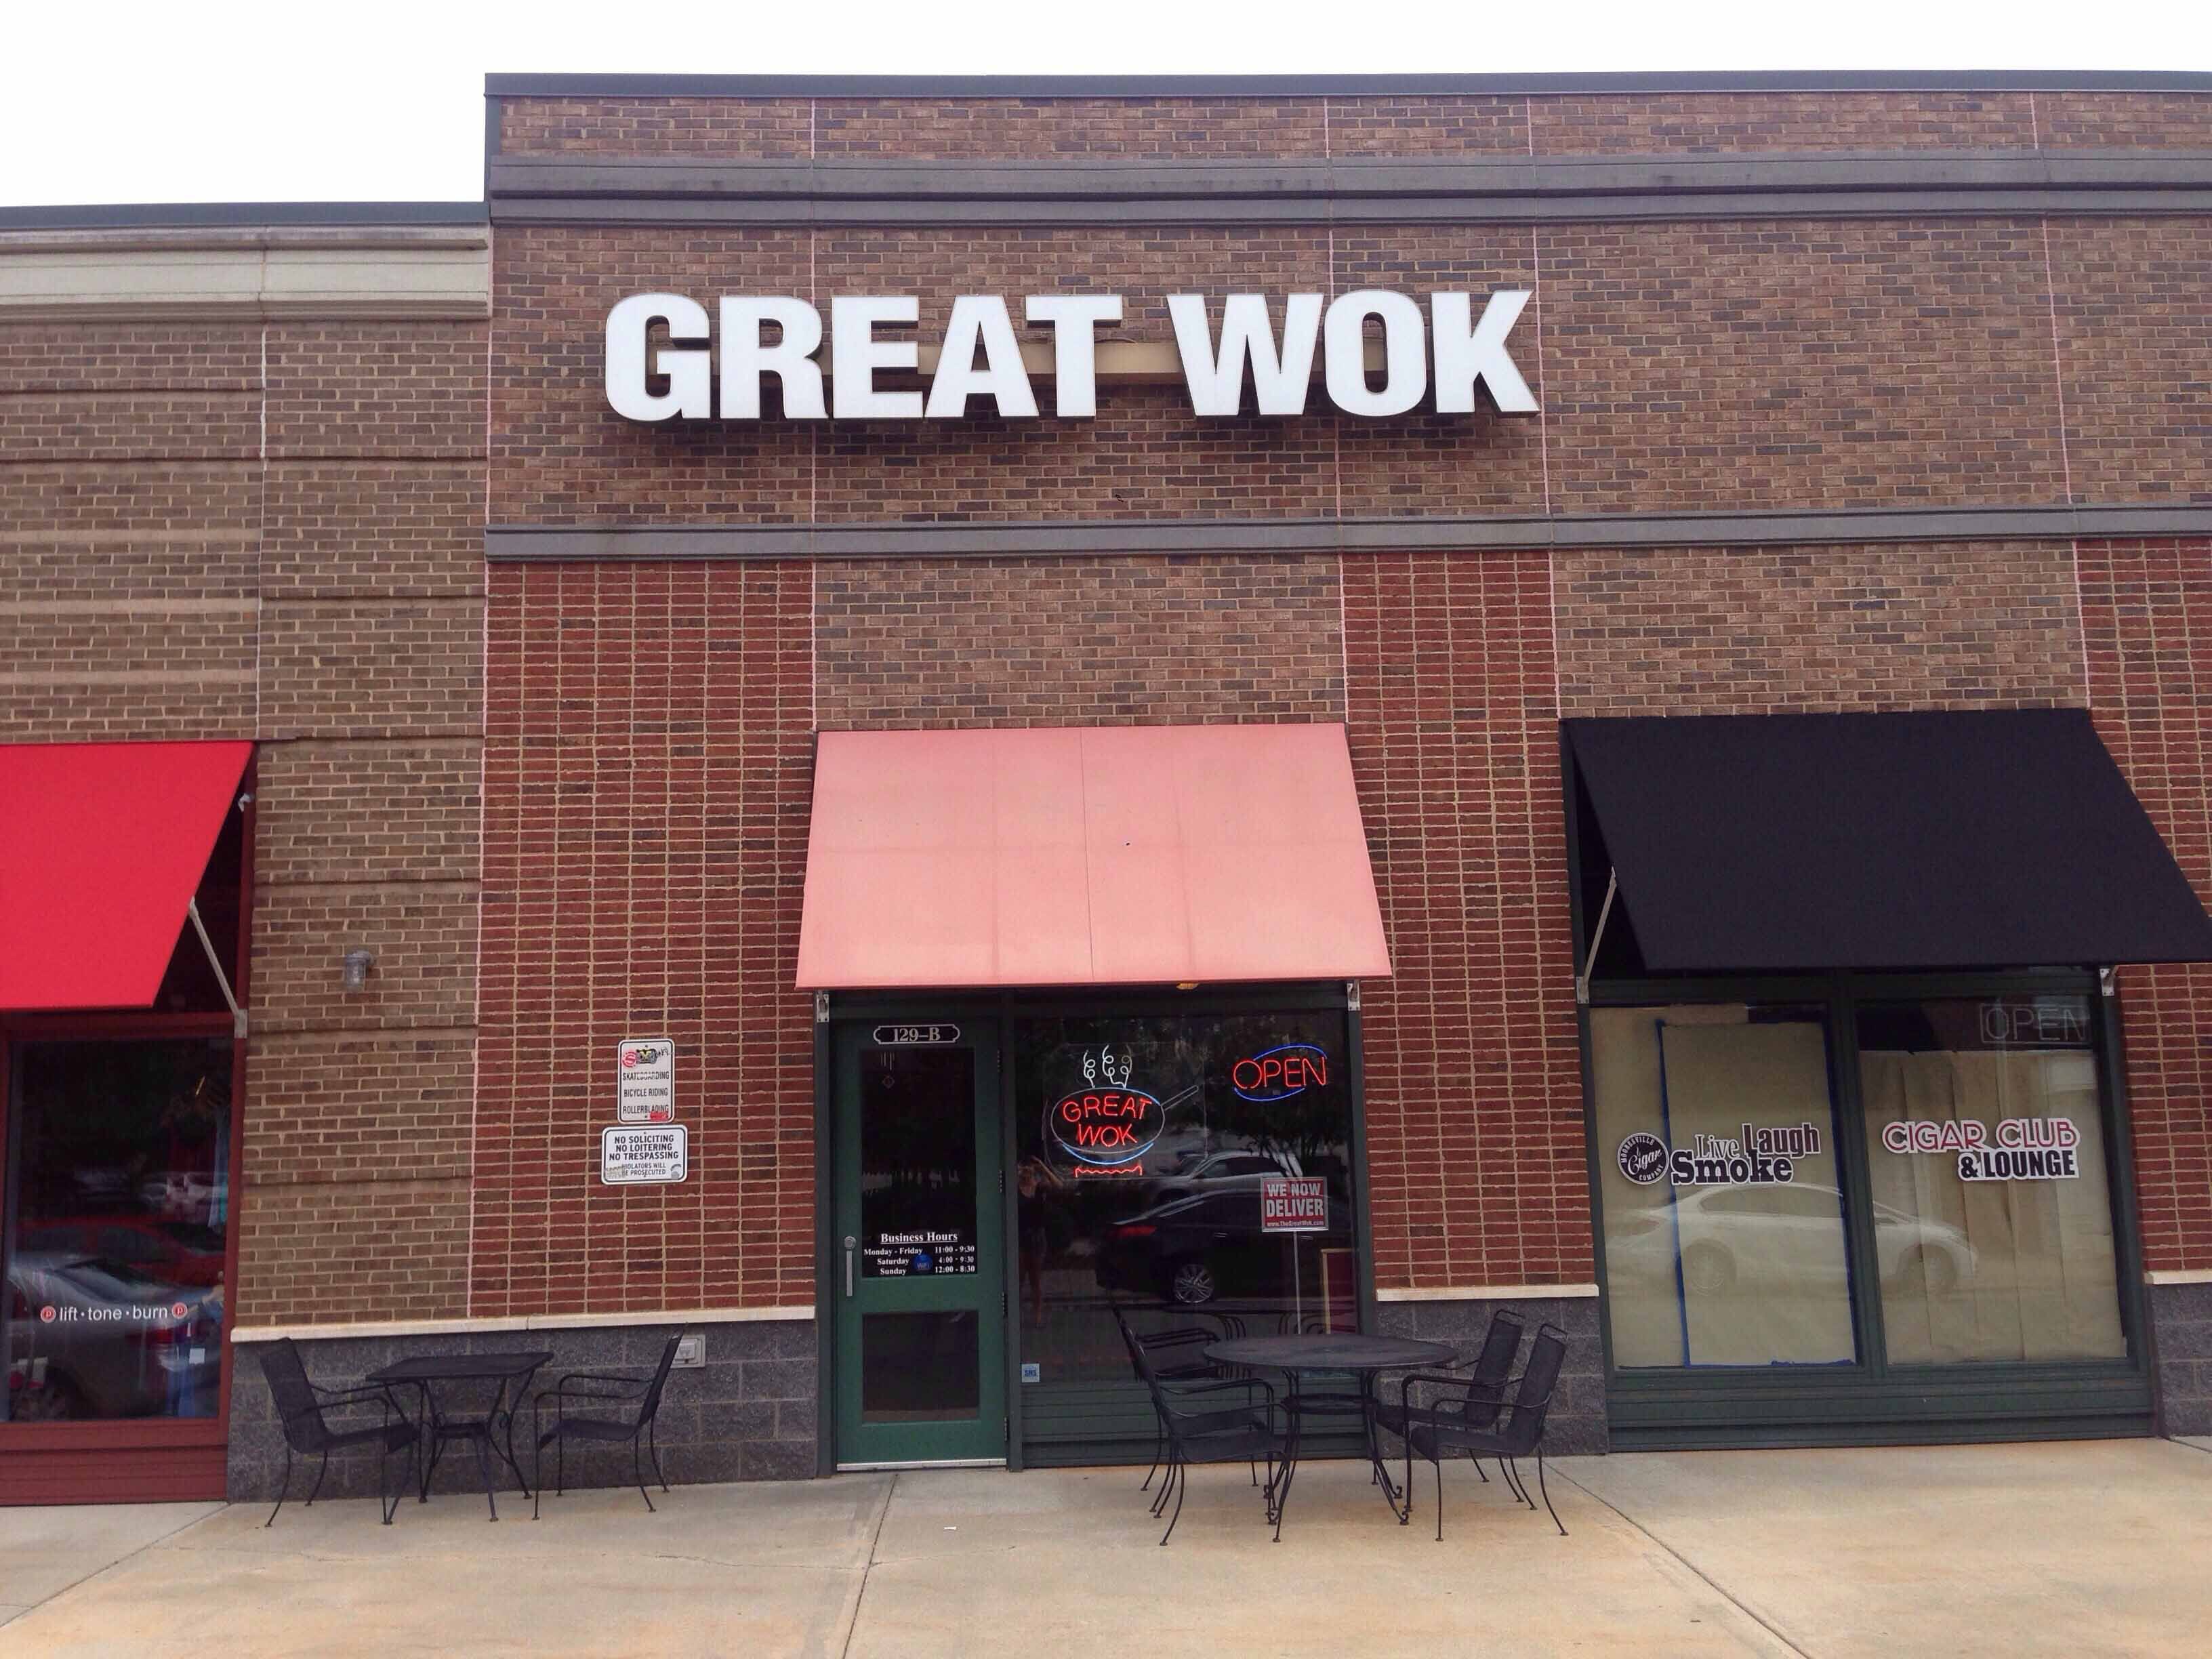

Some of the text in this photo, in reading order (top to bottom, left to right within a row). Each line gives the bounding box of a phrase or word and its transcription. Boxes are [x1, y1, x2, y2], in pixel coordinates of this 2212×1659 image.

[605, 289, 1541, 422] GREAT WOK
[1986, 1007, 2087, 1041] OPEN
[1233, 1056, 1327, 1090] OPEN
[623, 1087, 668, 1097] BICYCLE RIDING
[623, 1104, 670, 1115] ROLLERBLADING
[1062, 1095, 1153, 1147] GREAT WOK
[615, 1134, 674, 1144] NO SOLICITING
[1696, 1123, 1820, 1159] Live Laugh
[1883, 1120, 2078, 1151] CIGAR CLUB
[616, 1143, 672, 1152] NO LOITERING
[623, 1151, 679, 1160] TRESPASSING
[1620, 1136, 1655, 1164] MOORESVILLE
[1628, 1145, 1662, 1176] Cigar
[1671, 1150, 1793, 1184] Smoke
[1984, 1150, 2076, 1179] LOUNGE
[1639, 1164, 1664, 1181] COMPANY
[1267, 1183, 1321, 1197] WE NOW
[1266, 1198, 1324, 1218] DELIVER
[880, 1231, 958, 1243] Business Hours
[863, 1248, 893, 1256] Monday
[899, 1247, 923, 1256] Friday
[935, 1246, 954, 1254] 11:00
[877, 1258, 909, 1266] Saturday
[880, 1268, 907, 1276] Sunday
[60, 1306, 78, 1321] lift
[87, 1307, 122, 1321] tone
[132, 1305, 168, 1319] burn
